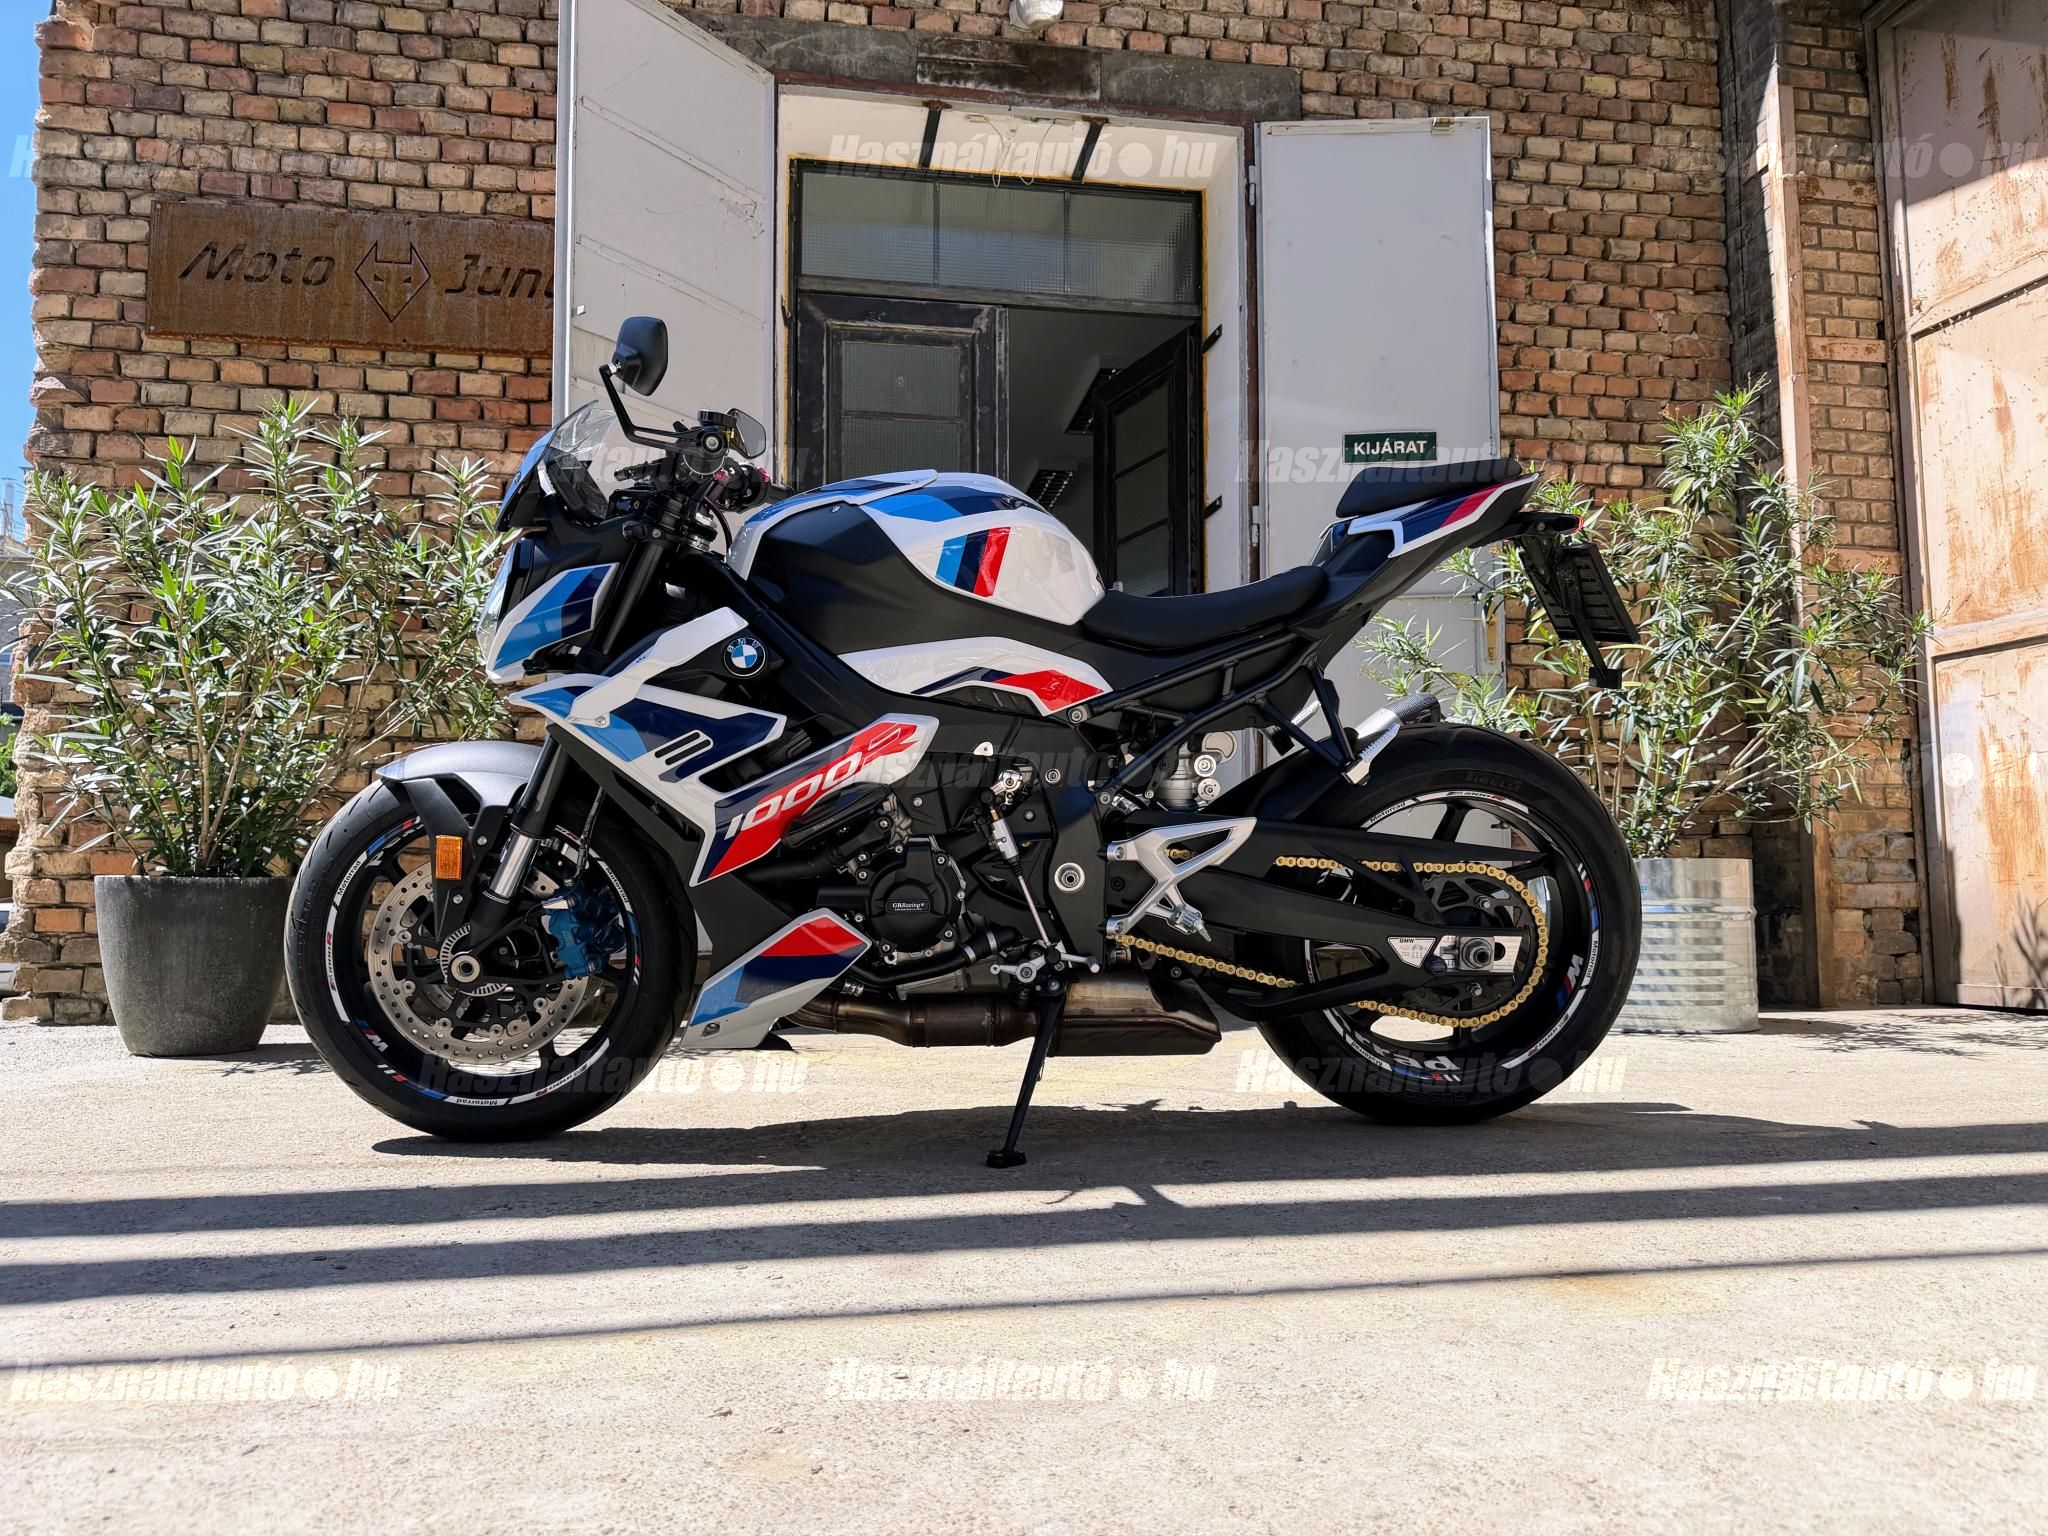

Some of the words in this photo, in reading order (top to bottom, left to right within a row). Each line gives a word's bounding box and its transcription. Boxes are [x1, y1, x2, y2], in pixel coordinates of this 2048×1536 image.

[178, 241, 336, 286] Moto
[1353, 437, 1427, 455] KIJÁRAT
[1369, 800, 1406, 823] Motorrad
[337, 860, 362, 896] Motorrad
[605, 867, 629, 903] Motorrad
[1586, 940, 1599, 978] Motorrad
[1350, 1041, 1383, 1066] Motorrad
[456, 1098, 498, 1106] Motorrad
